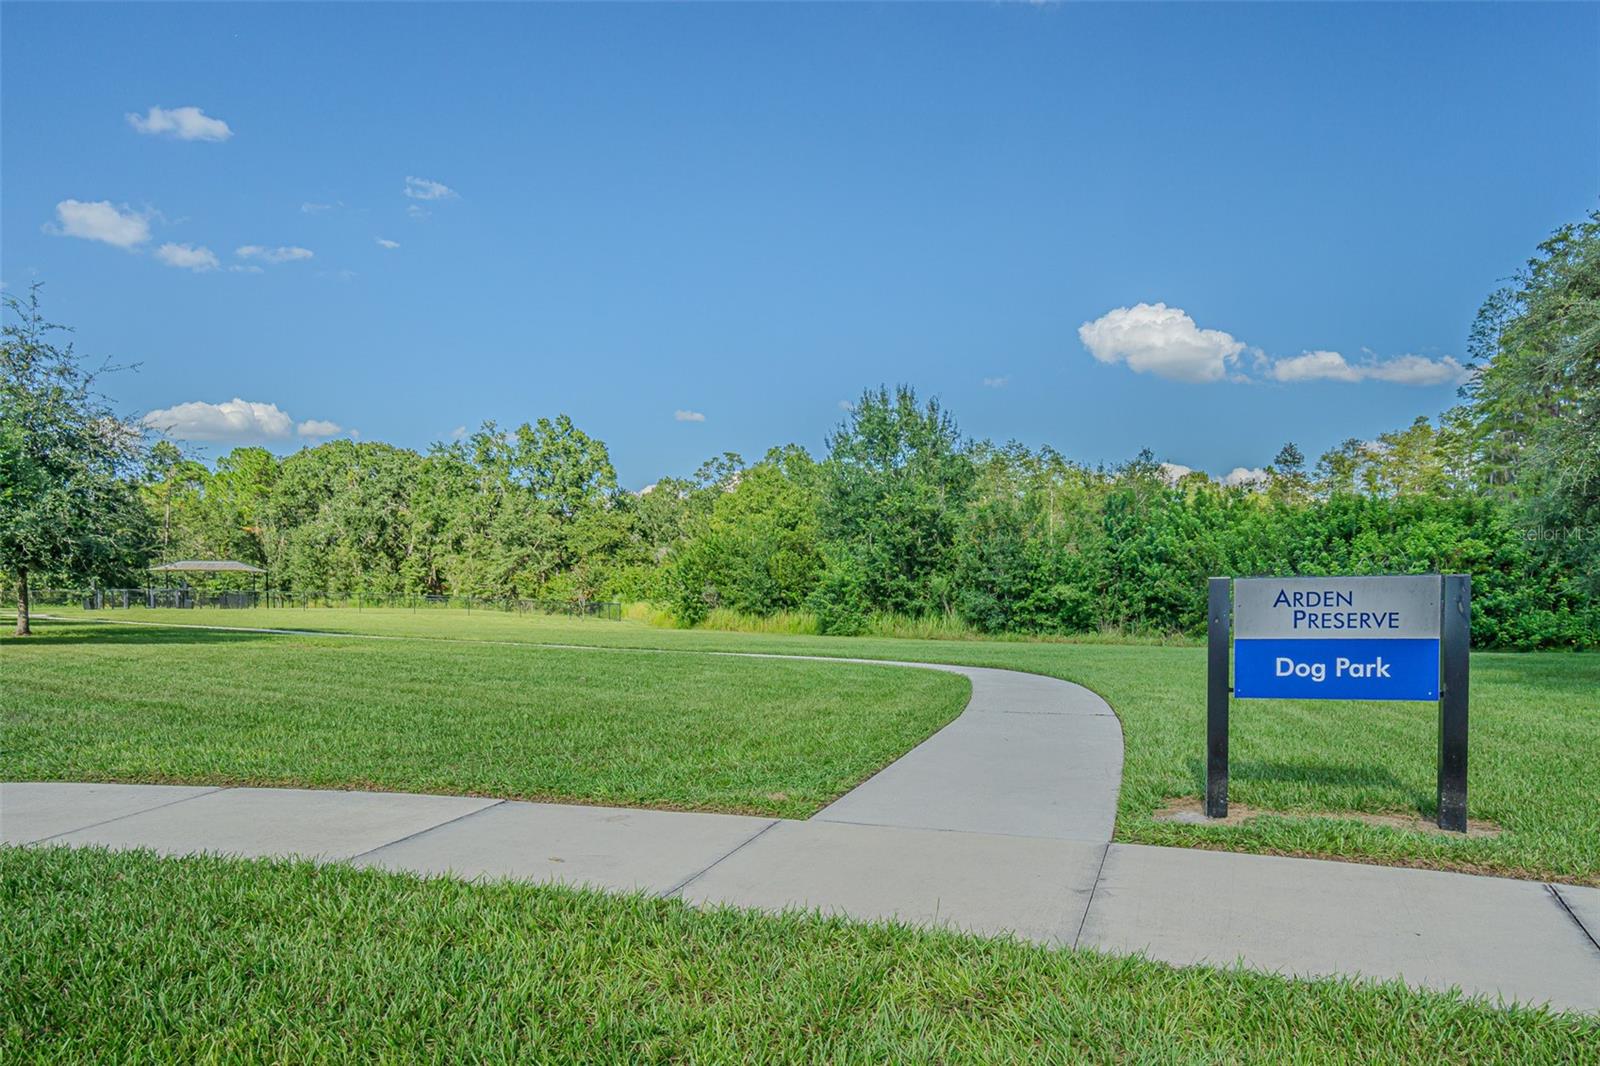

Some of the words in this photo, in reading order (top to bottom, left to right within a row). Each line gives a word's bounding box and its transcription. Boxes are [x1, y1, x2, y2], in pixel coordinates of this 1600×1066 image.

[1273, 589, 1353, 609] ARDEN
[1293, 610, 1400, 630] PRESERVE
[1275, 656, 1326, 683] Dog
[1336, 656, 1392, 679] Park
